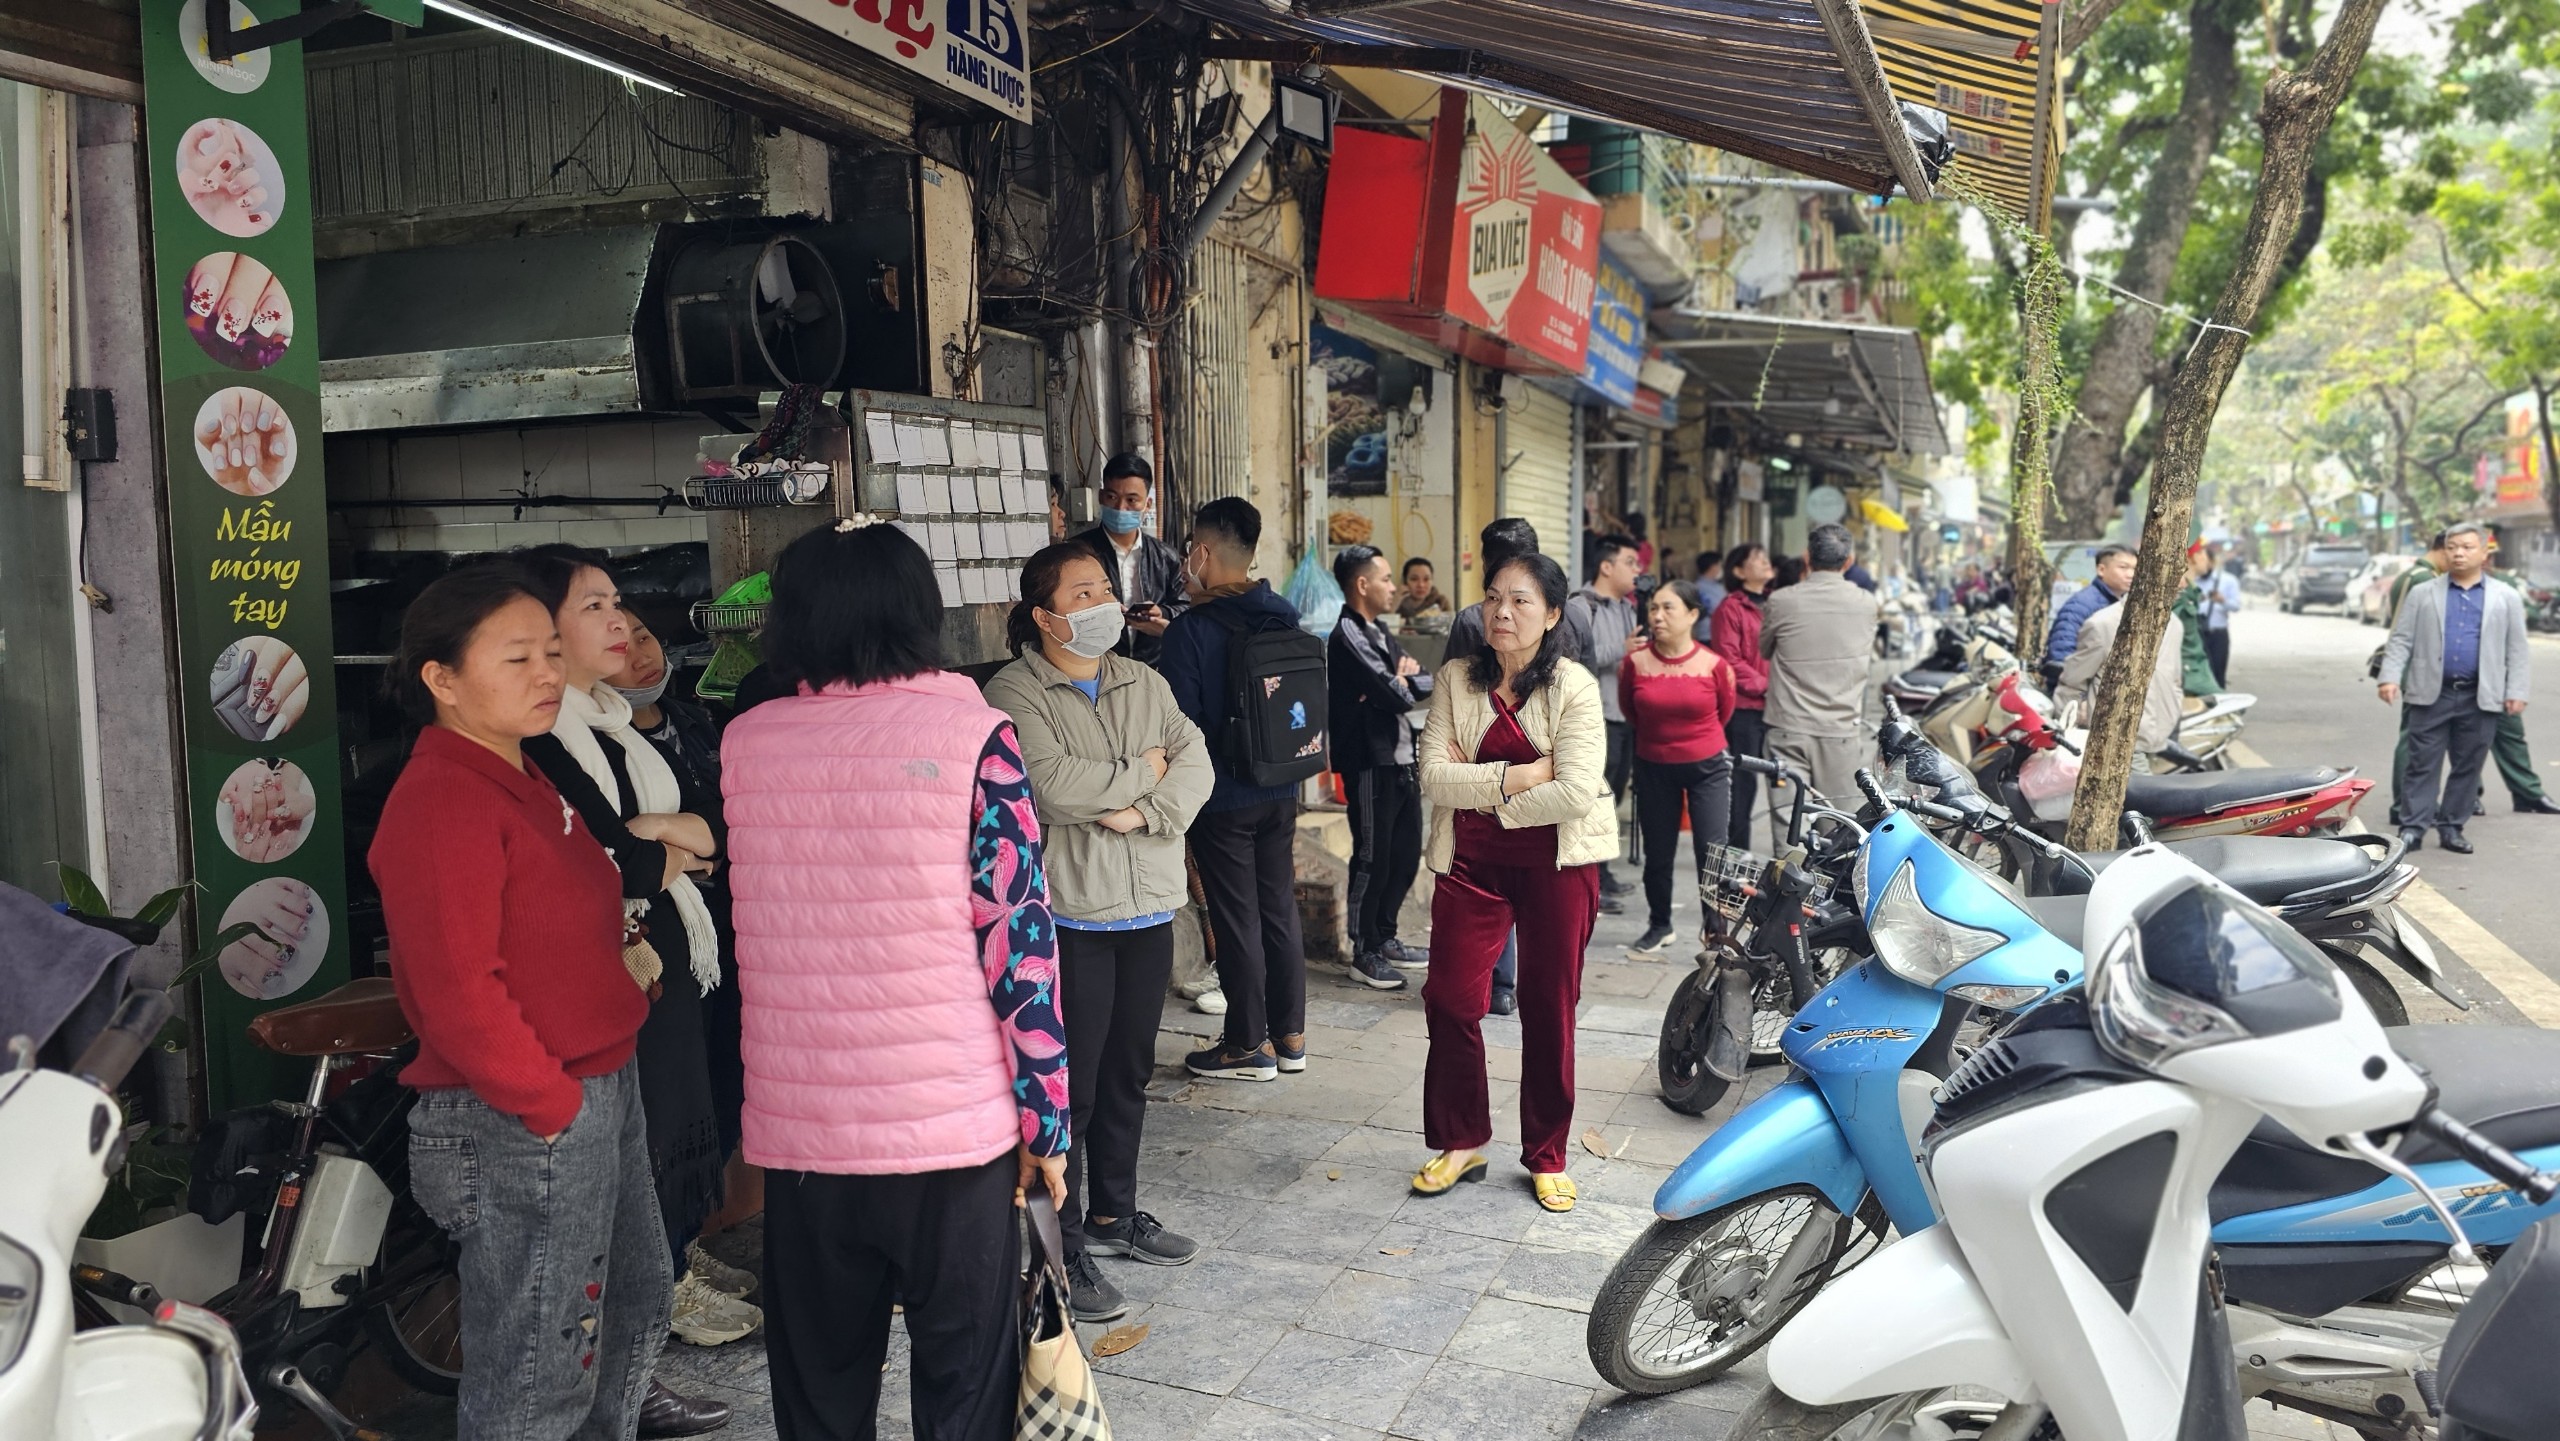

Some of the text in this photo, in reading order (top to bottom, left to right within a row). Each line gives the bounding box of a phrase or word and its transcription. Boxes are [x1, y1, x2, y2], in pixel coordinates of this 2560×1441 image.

[962, 0, 1010, 54] 15
[946, 43, 1025, 109] HÀNG LƯỢC
[1473, 210, 1529, 276] BIA VIỆT
[216, 500, 292, 542] Mẫu
[210, 545, 300, 590] móng
[229, 592, 288, 630] tay
